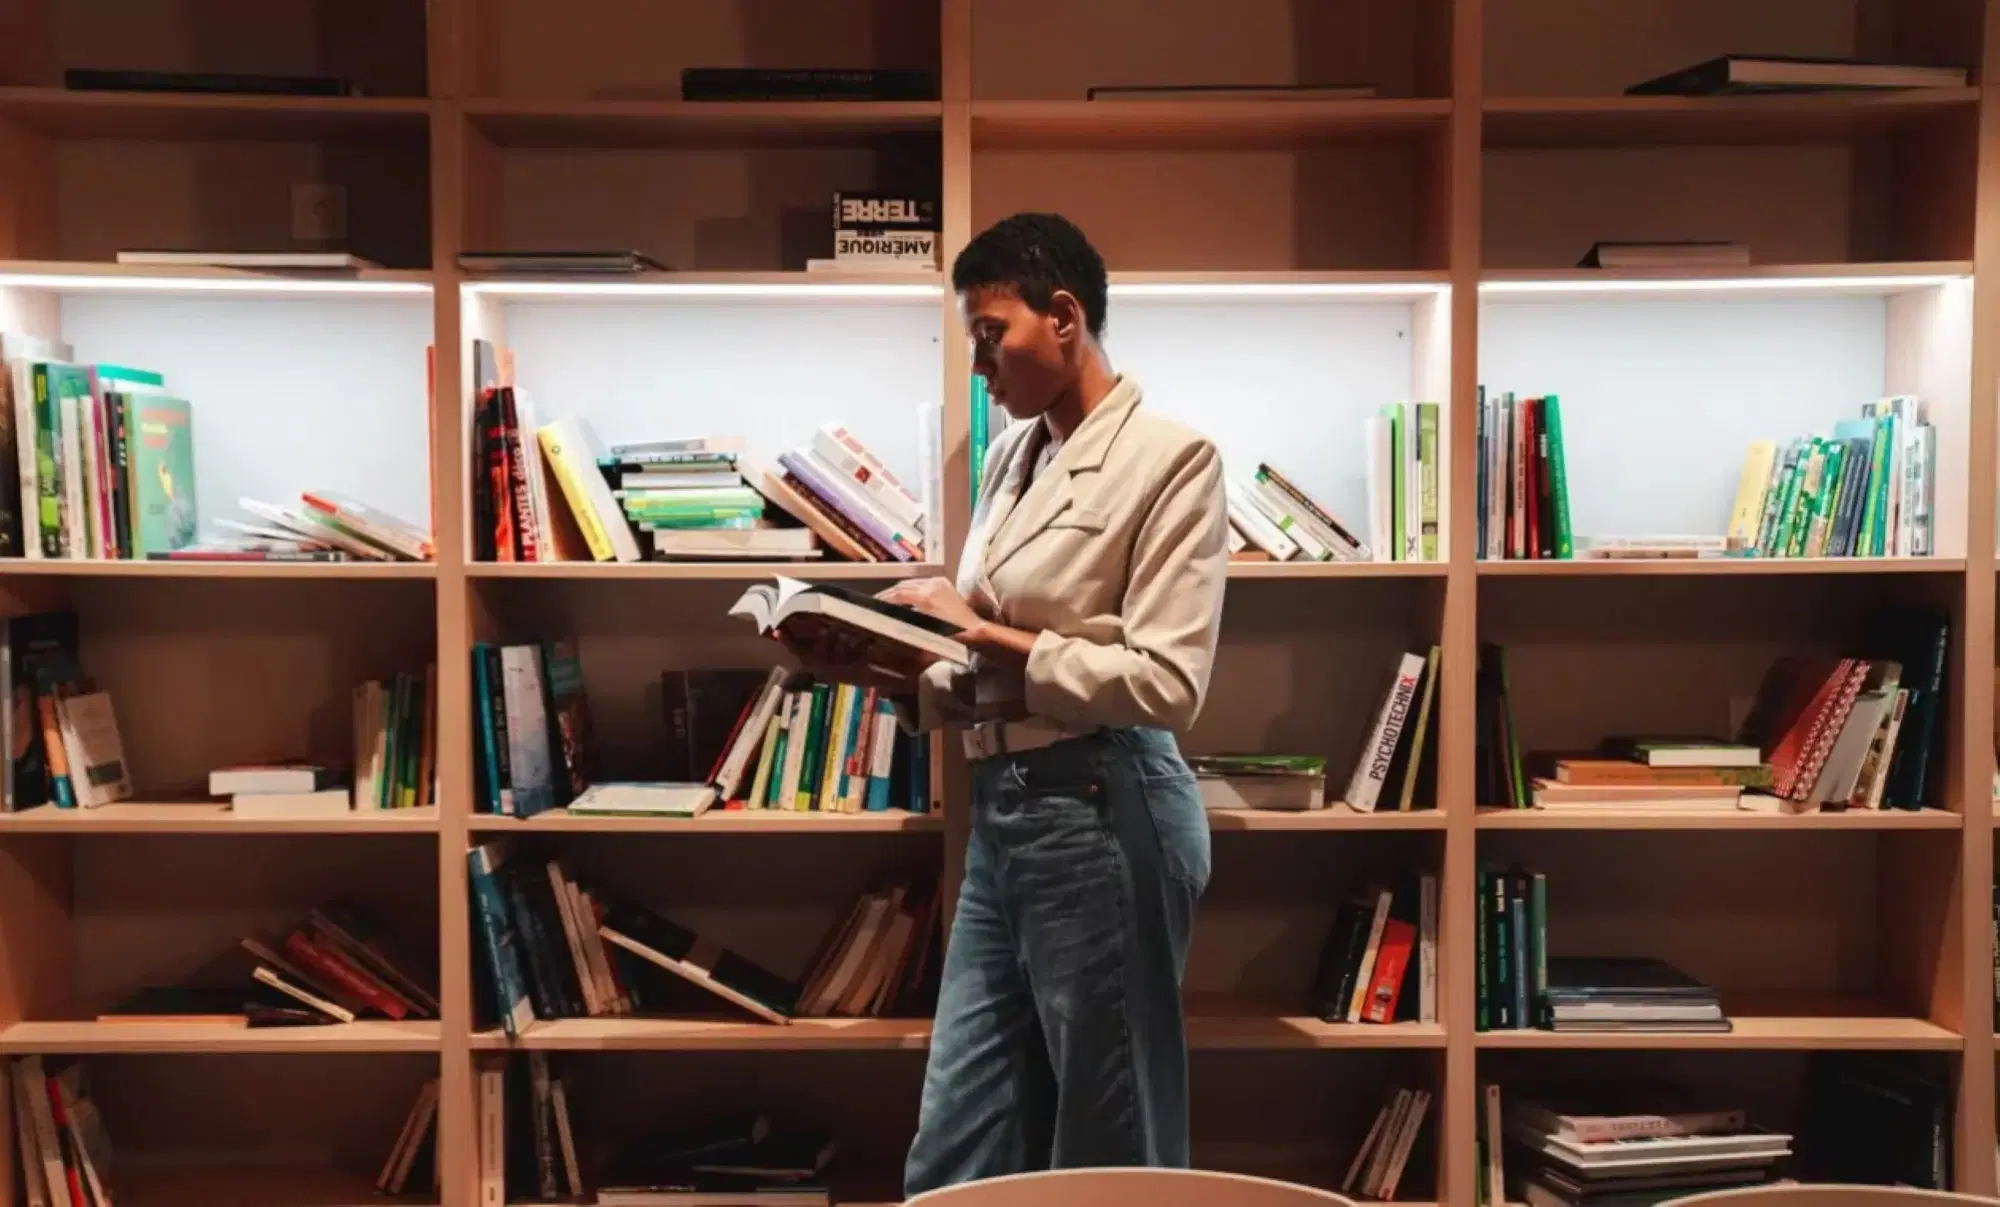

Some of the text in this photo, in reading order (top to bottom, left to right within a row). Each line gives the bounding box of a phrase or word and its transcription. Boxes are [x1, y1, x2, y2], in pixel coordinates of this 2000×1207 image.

[841, 199, 920, 222] TERRE
[838, 240, 932, 258] AMÉRIQUE
[1368, 675, 1416, 780] PSYCHOTECHNIX
